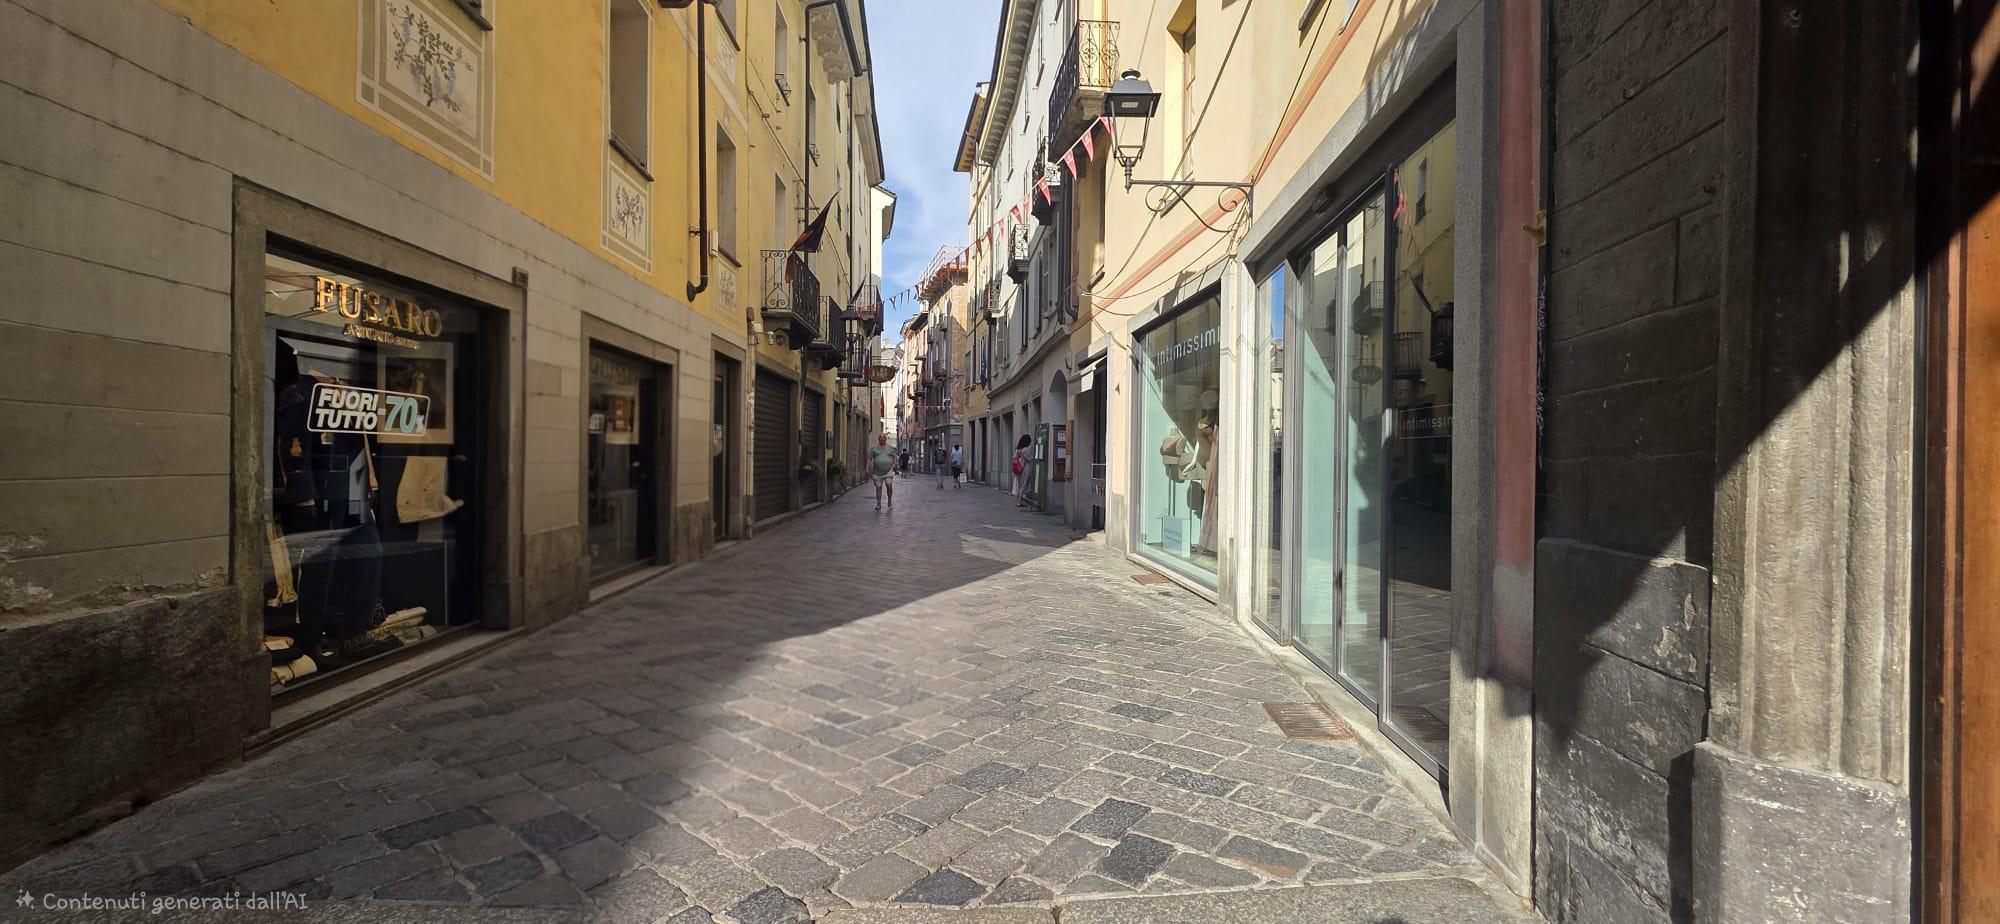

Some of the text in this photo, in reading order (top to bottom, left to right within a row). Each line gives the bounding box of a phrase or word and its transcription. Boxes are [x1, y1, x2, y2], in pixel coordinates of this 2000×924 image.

[313, 276, 442, 337] FUSARO
[318, 388, 379, 412] FUORI
[315, 407, 378, 430] TUTTO
